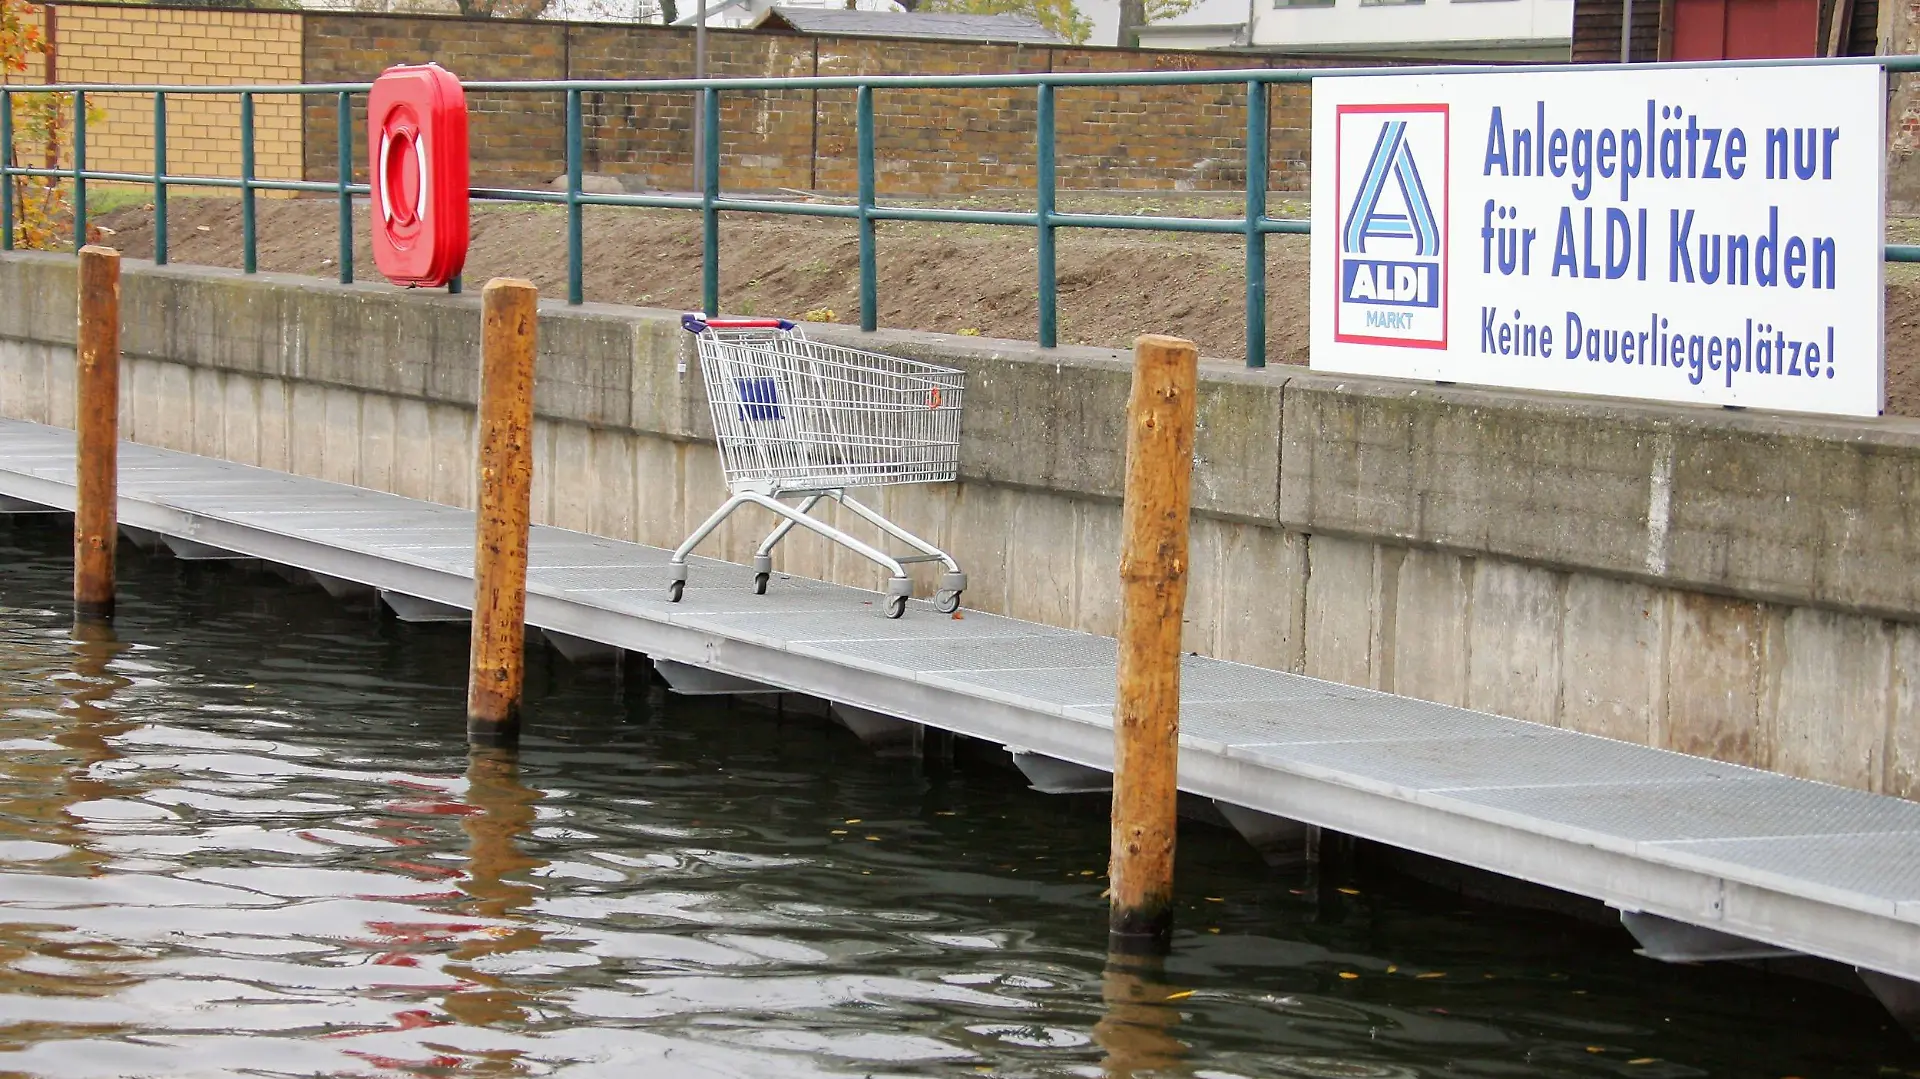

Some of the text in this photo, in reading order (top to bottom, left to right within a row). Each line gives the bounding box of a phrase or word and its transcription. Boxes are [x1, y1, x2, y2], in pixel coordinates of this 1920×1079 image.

[1484, 100, 1840, 201] Anlegeplätze nur
[1350, 264, 1429, 302] ALDI
[1481, 199, 1836, 289] für ALDI Kunden
[1366, 310, 1413, 330] MARKT
[1481, 306, 1835, 387] Keine Dauerliegeplätze!
